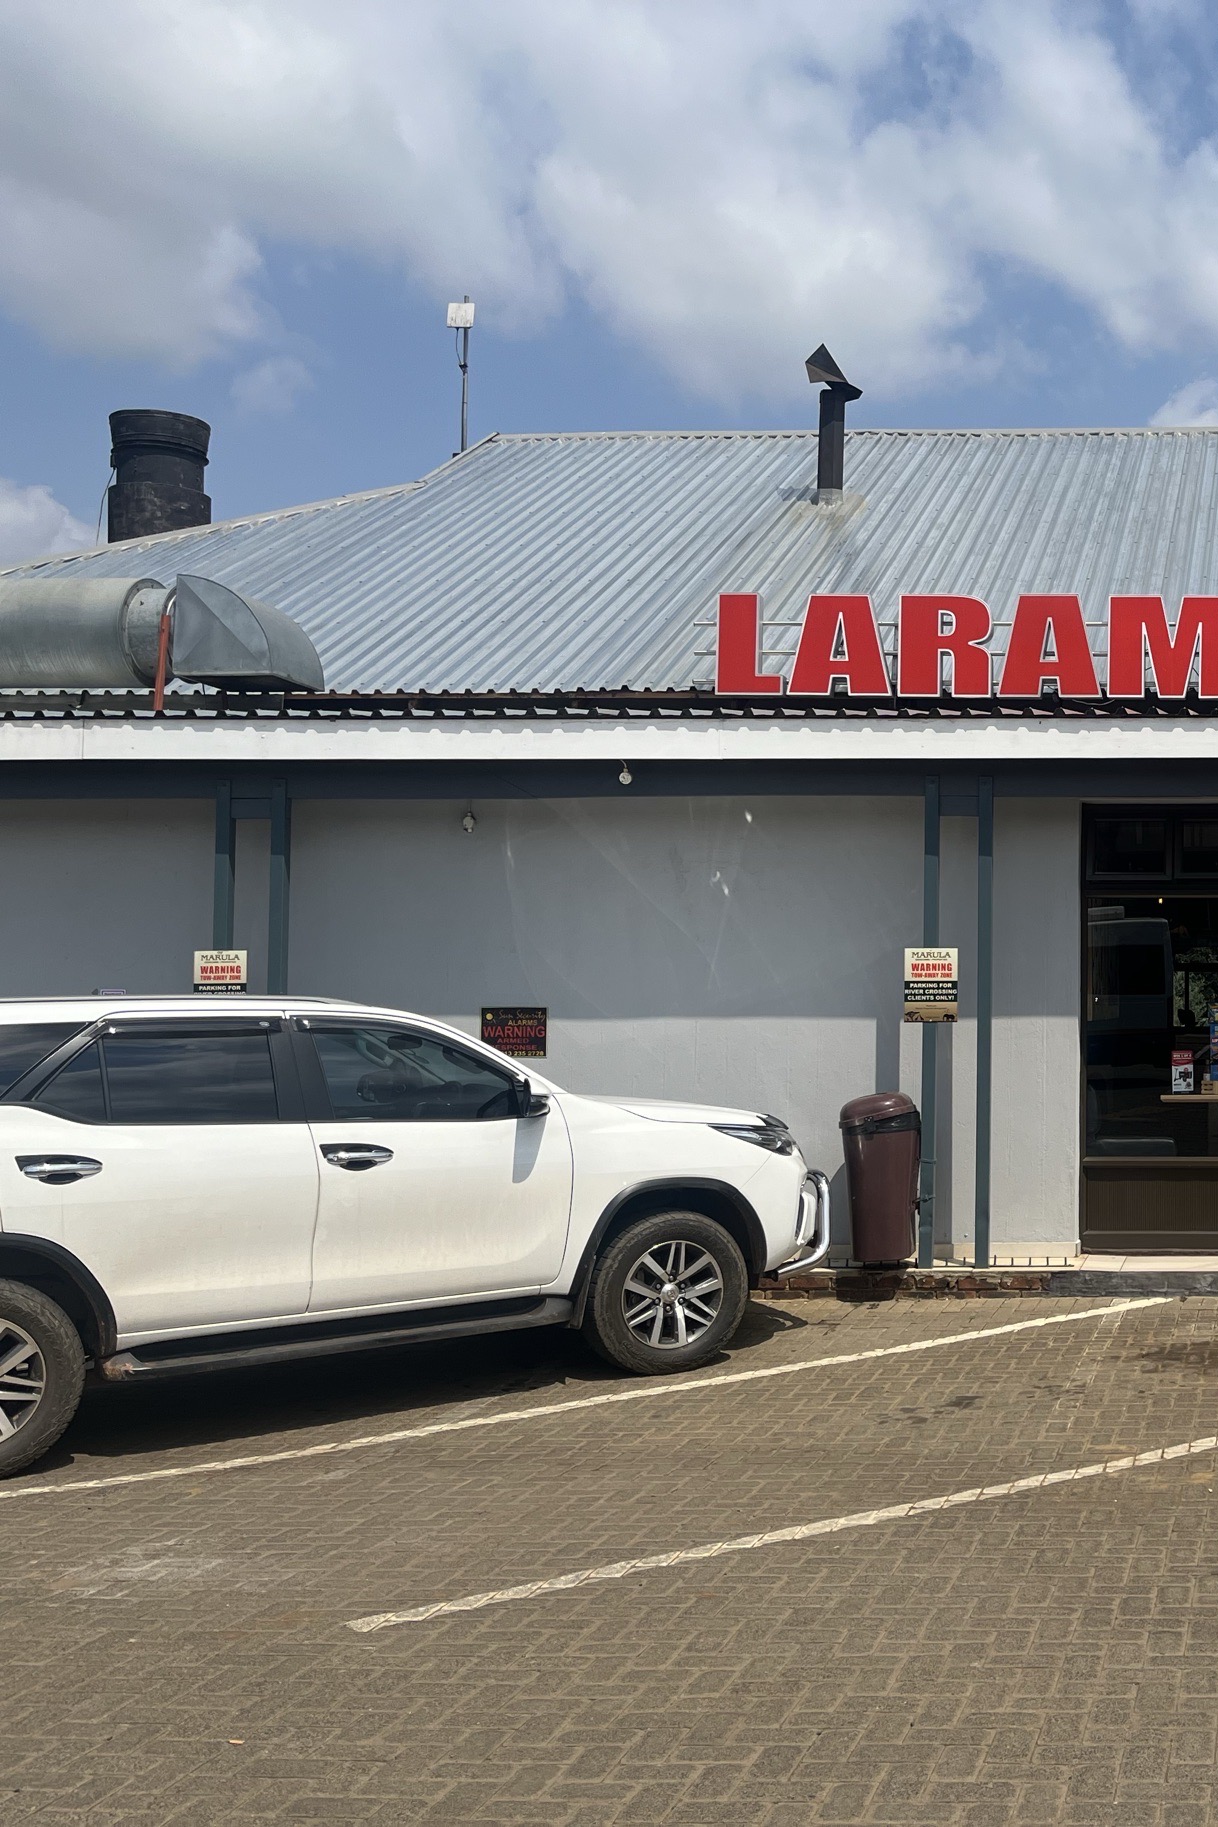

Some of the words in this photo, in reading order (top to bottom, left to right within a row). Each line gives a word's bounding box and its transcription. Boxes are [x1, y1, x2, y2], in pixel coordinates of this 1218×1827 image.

[911, 951, 952, 959] MARULA
[200, 965, 242, 974] WARNING
[911, 963, 953, 972] WARNING
[516, 1010, 546, 1022] Security
[483, 1026, 546, 1038] WARNING
